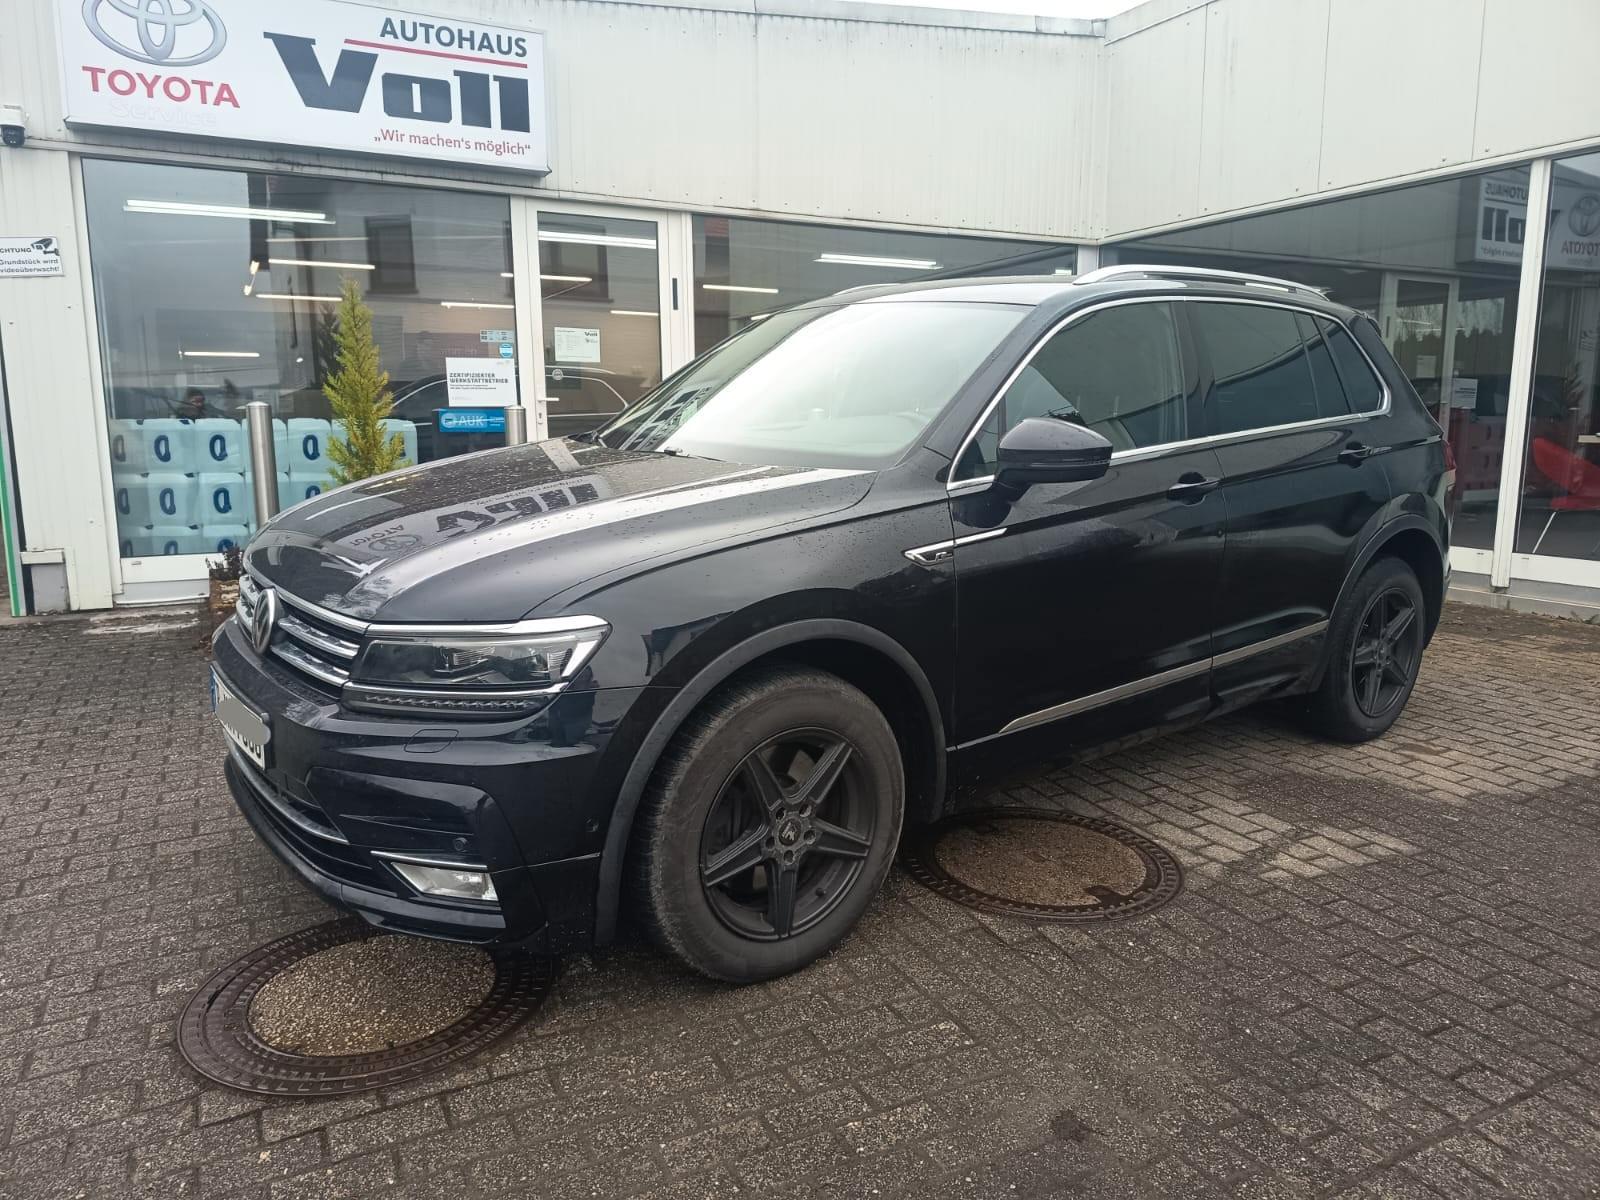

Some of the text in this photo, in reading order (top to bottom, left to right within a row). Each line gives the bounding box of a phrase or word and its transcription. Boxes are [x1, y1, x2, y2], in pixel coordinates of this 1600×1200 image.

[380, 17, 528, 58] AUTOHAUS
[82, 65, 241, 109] TOYOTA
[263, 31, 531, 133] Voll
